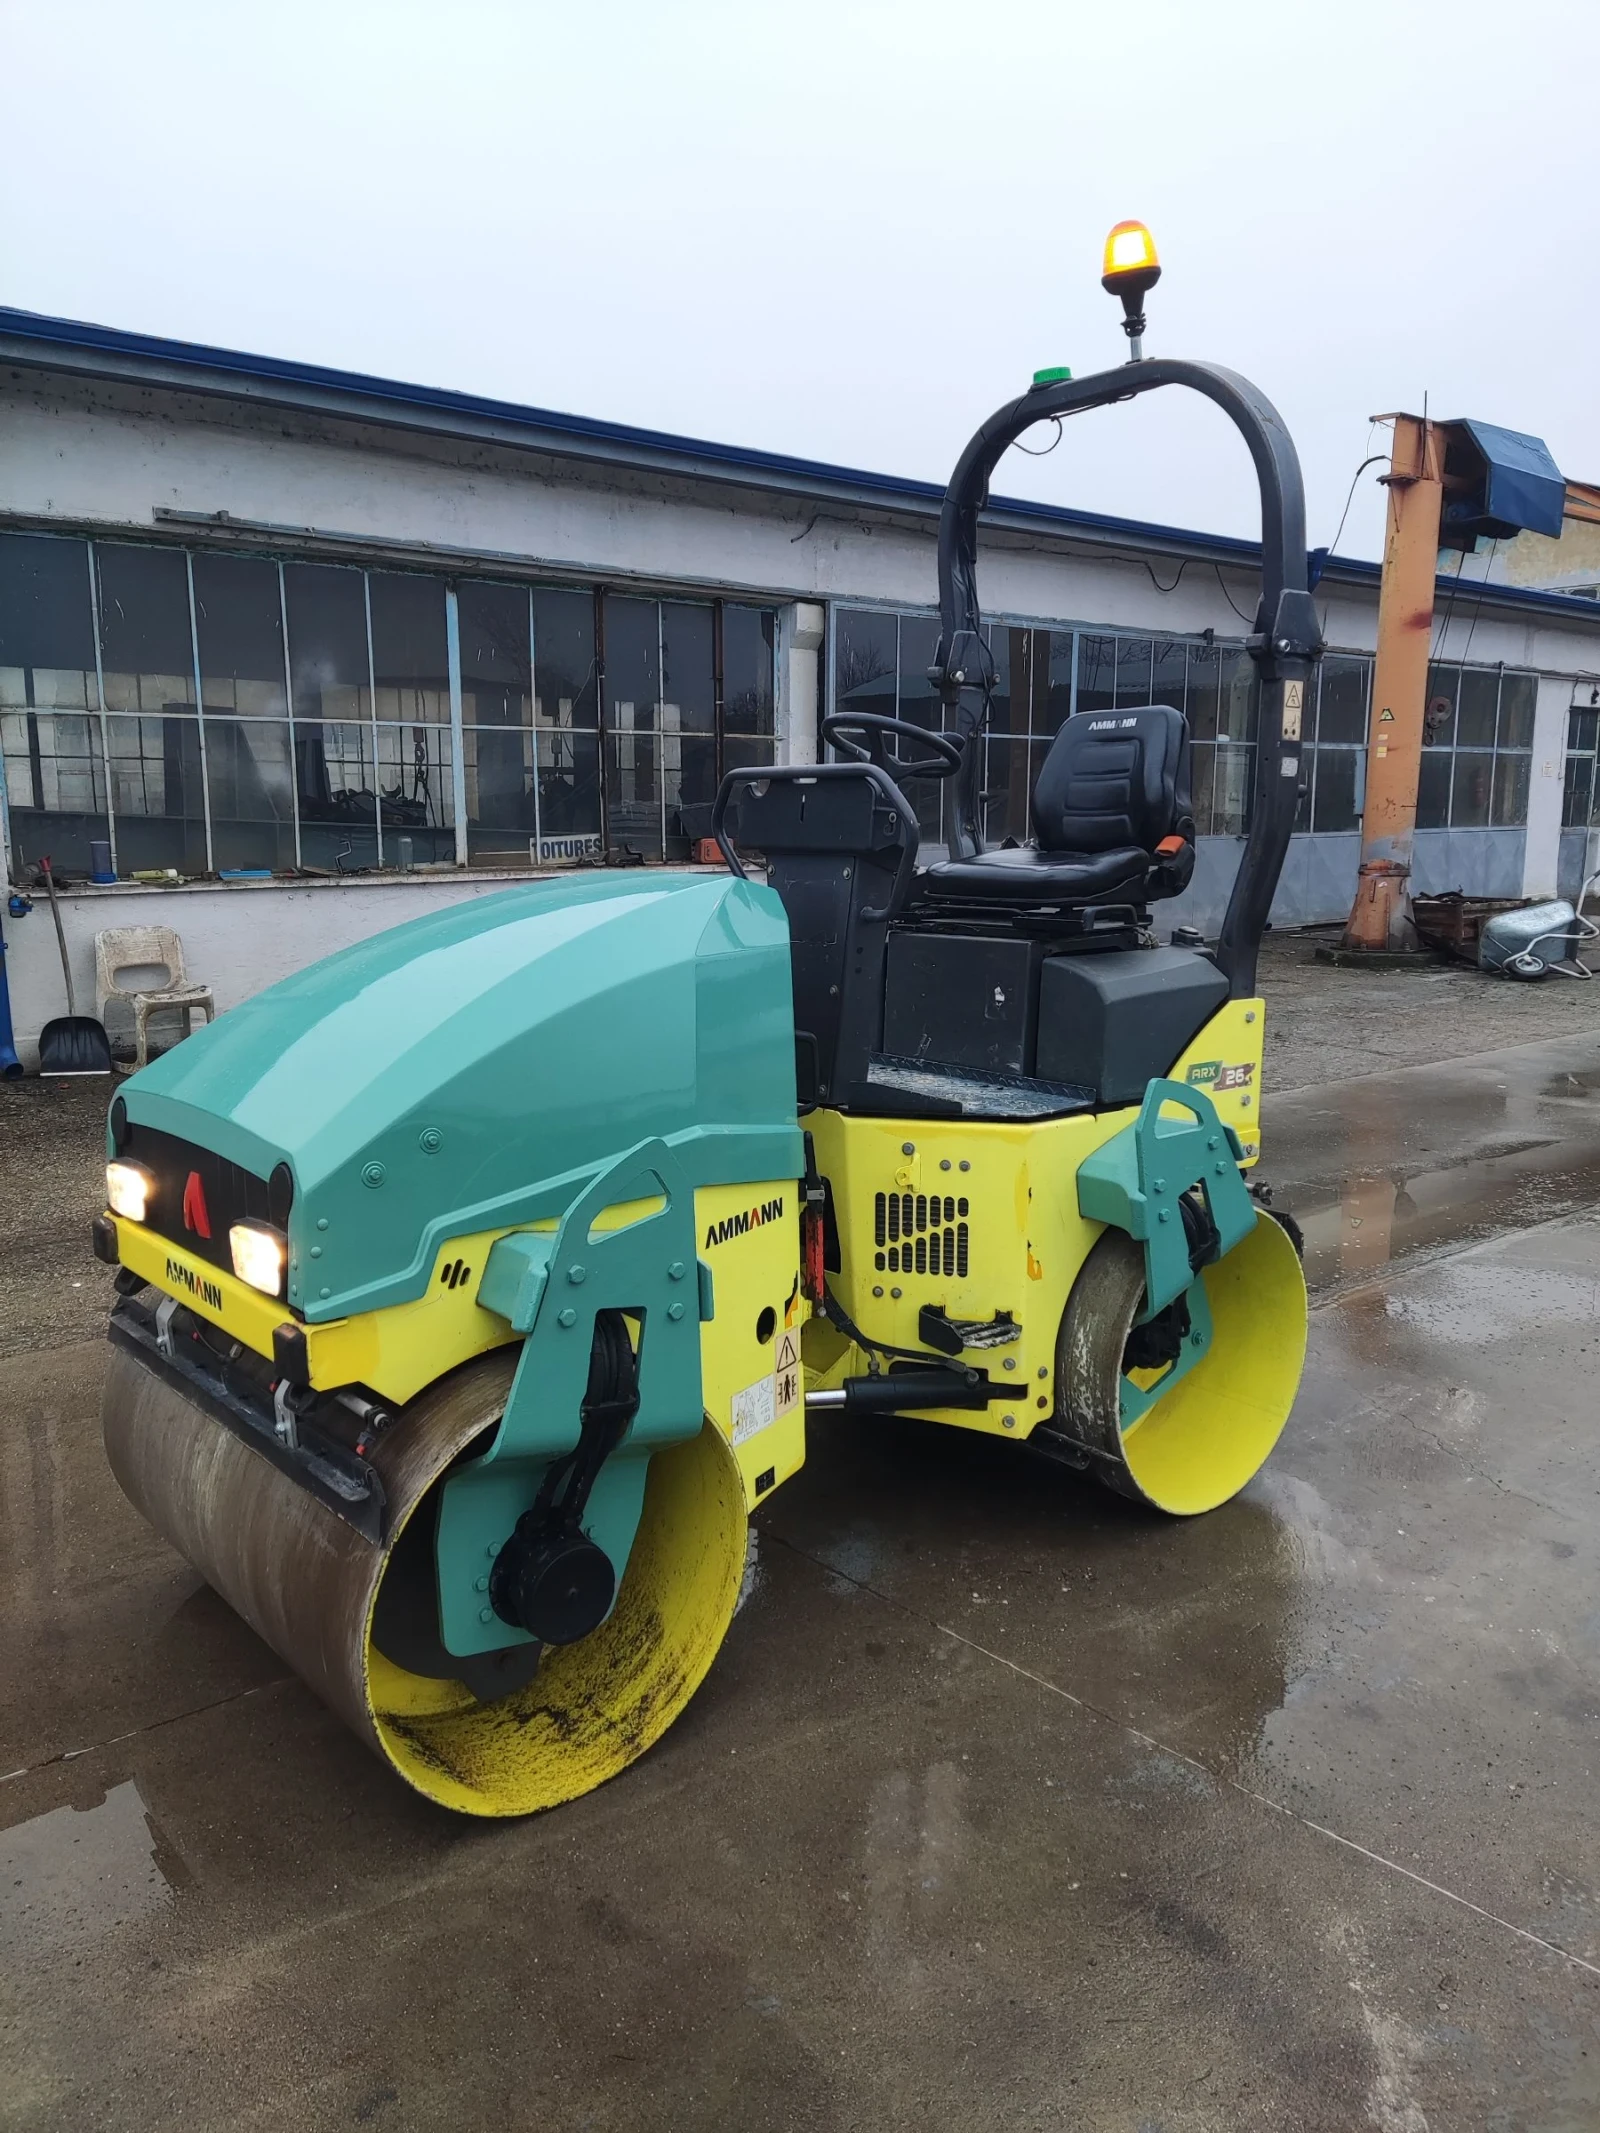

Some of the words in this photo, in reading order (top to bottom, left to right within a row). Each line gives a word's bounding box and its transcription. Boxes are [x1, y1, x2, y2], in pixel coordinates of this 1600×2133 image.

[1088, 717, 1138, 731] AMMANN
[1191, 1066, 1217, 1080] ARX
[1225, 1068, 1245, 1085] 26
[705, 1196, 783, 1251] AMMANN
